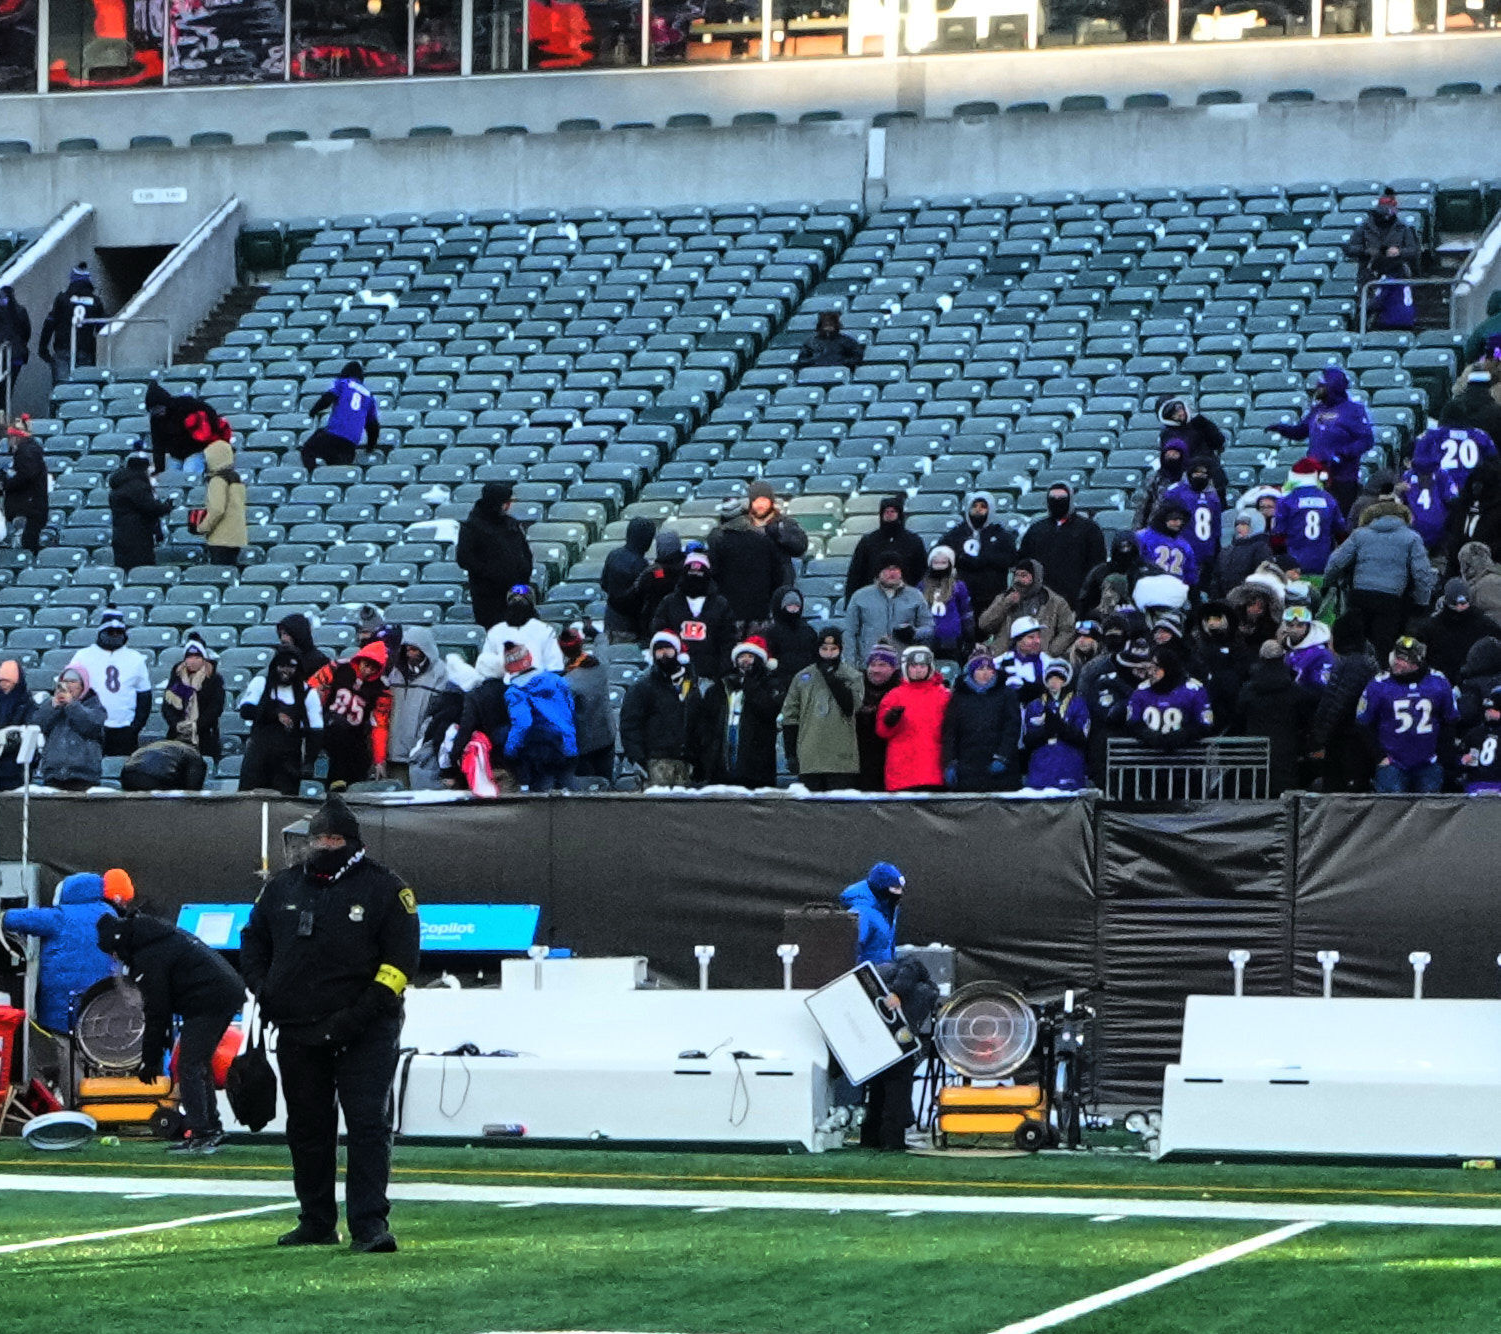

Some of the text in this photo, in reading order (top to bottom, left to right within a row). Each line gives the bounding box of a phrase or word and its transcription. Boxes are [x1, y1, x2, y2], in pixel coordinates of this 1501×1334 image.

[1440, 439, 1479, 469] 20
[1195, 507, 1211, 541] 8
[1305, 510, 1320, 540] 8
[105, 665, 120, 692] 8
[1393, 698, 1433, 734] 52
[1480, 737, 1498, 767] 8
